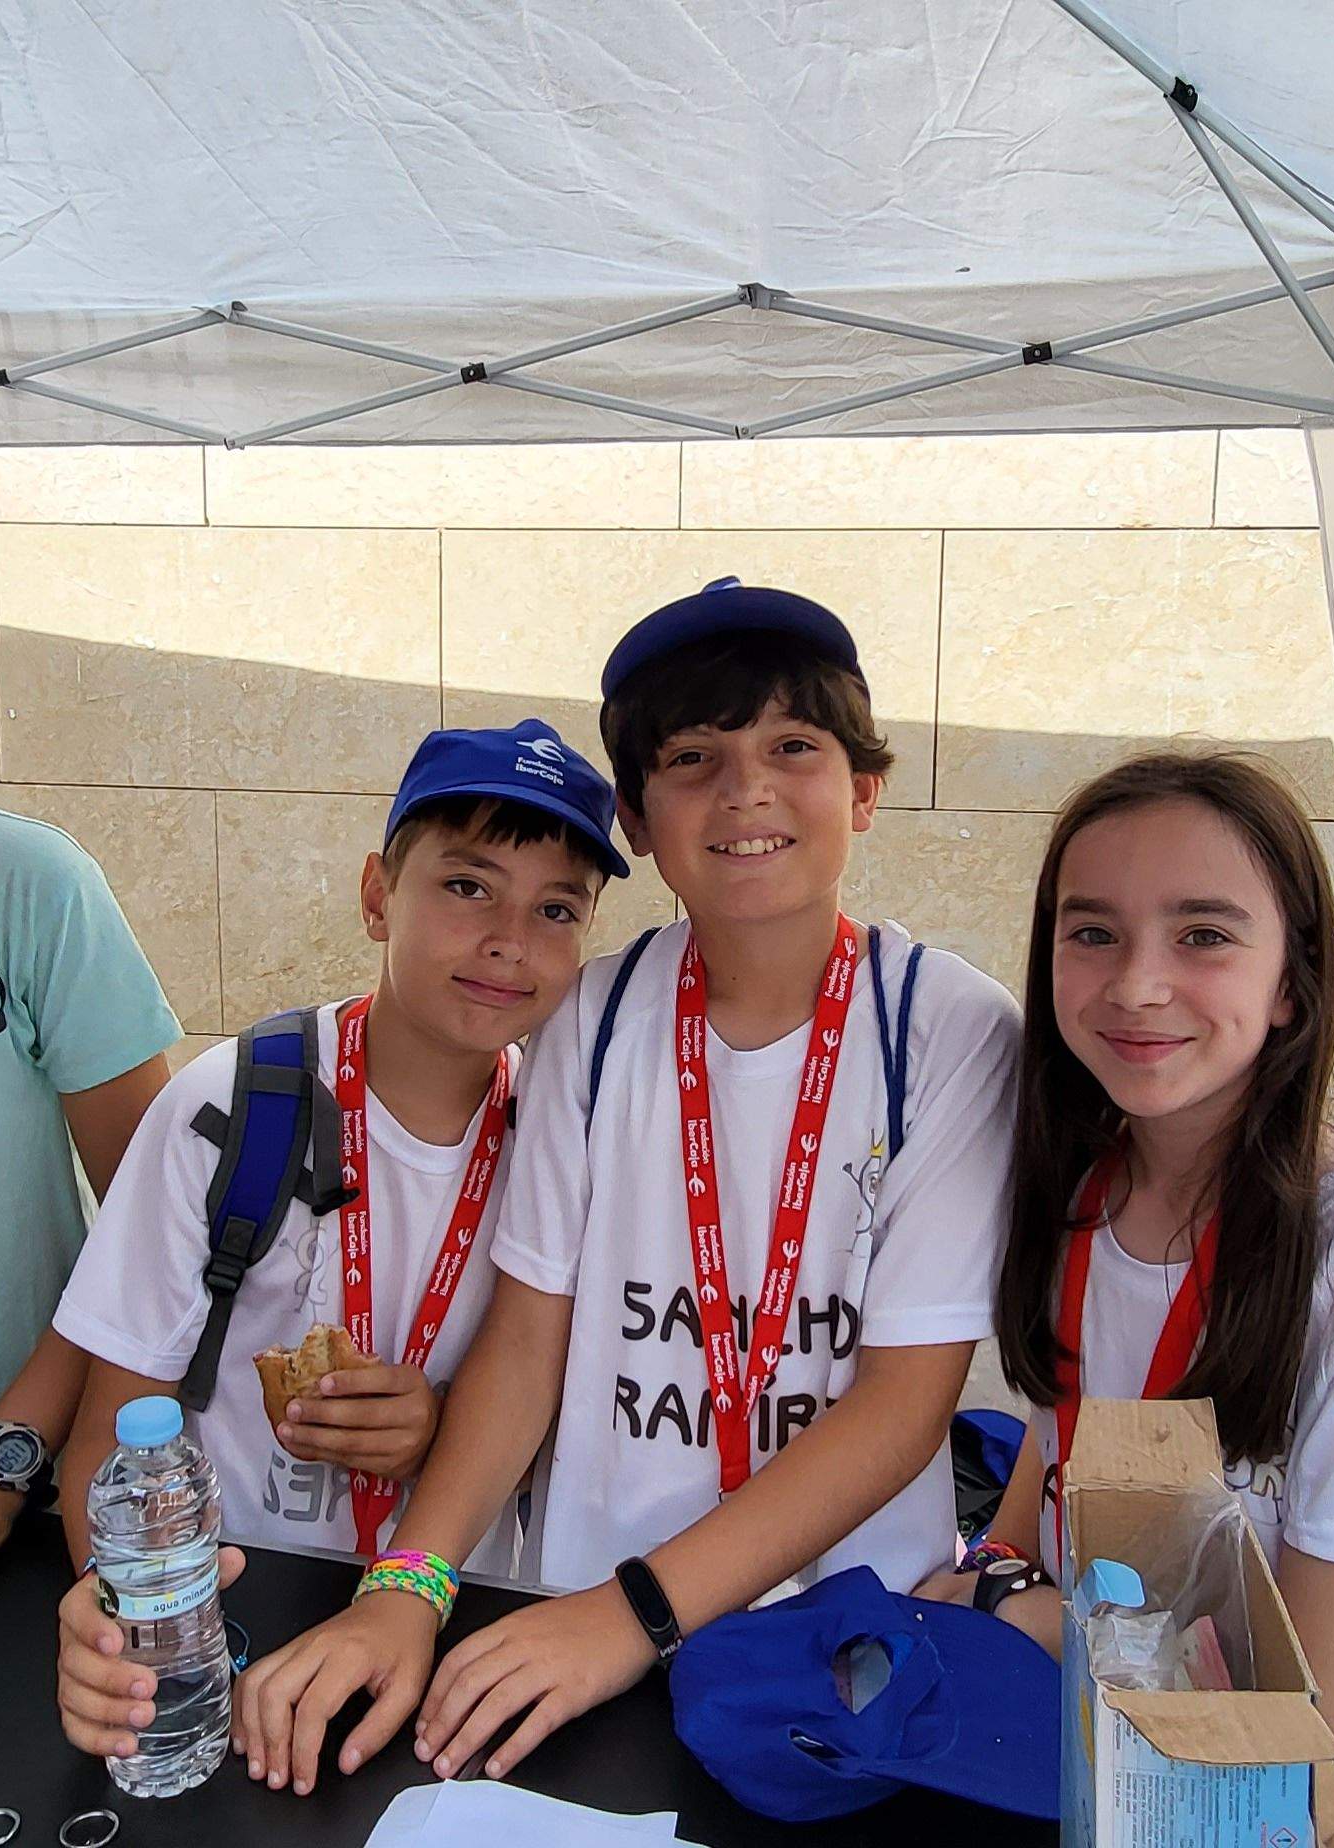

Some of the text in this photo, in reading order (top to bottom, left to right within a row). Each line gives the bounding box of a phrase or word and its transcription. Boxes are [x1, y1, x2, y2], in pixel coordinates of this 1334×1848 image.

[517, 756, 564, 777] Fundación
[154, 1579, 213, 1613] agua mineral
